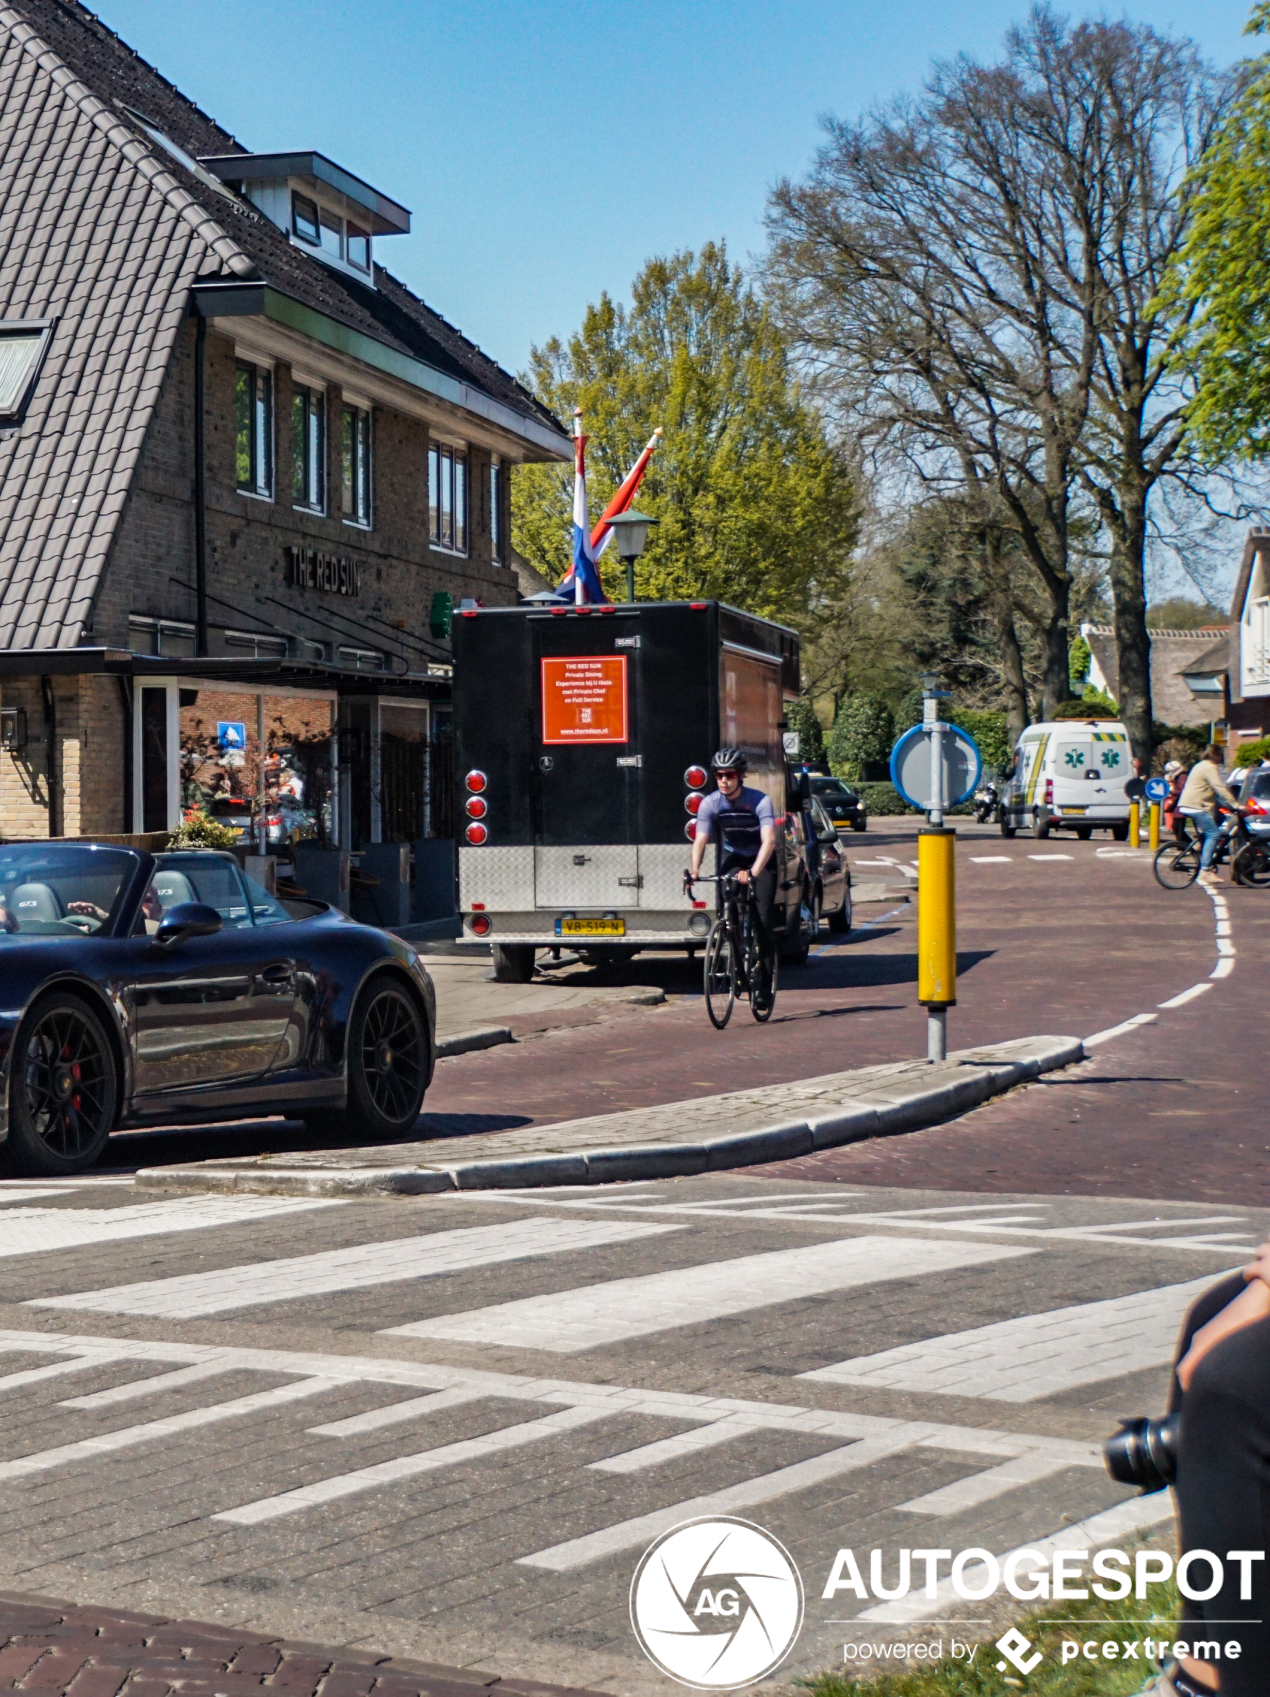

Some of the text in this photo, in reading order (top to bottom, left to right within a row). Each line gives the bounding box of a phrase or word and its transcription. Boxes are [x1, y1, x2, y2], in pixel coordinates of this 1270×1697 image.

[291, 546, 314, 587] THE
[316, 552, 339, 592] RED
[566, 921, 619, 932] VB-519-N
